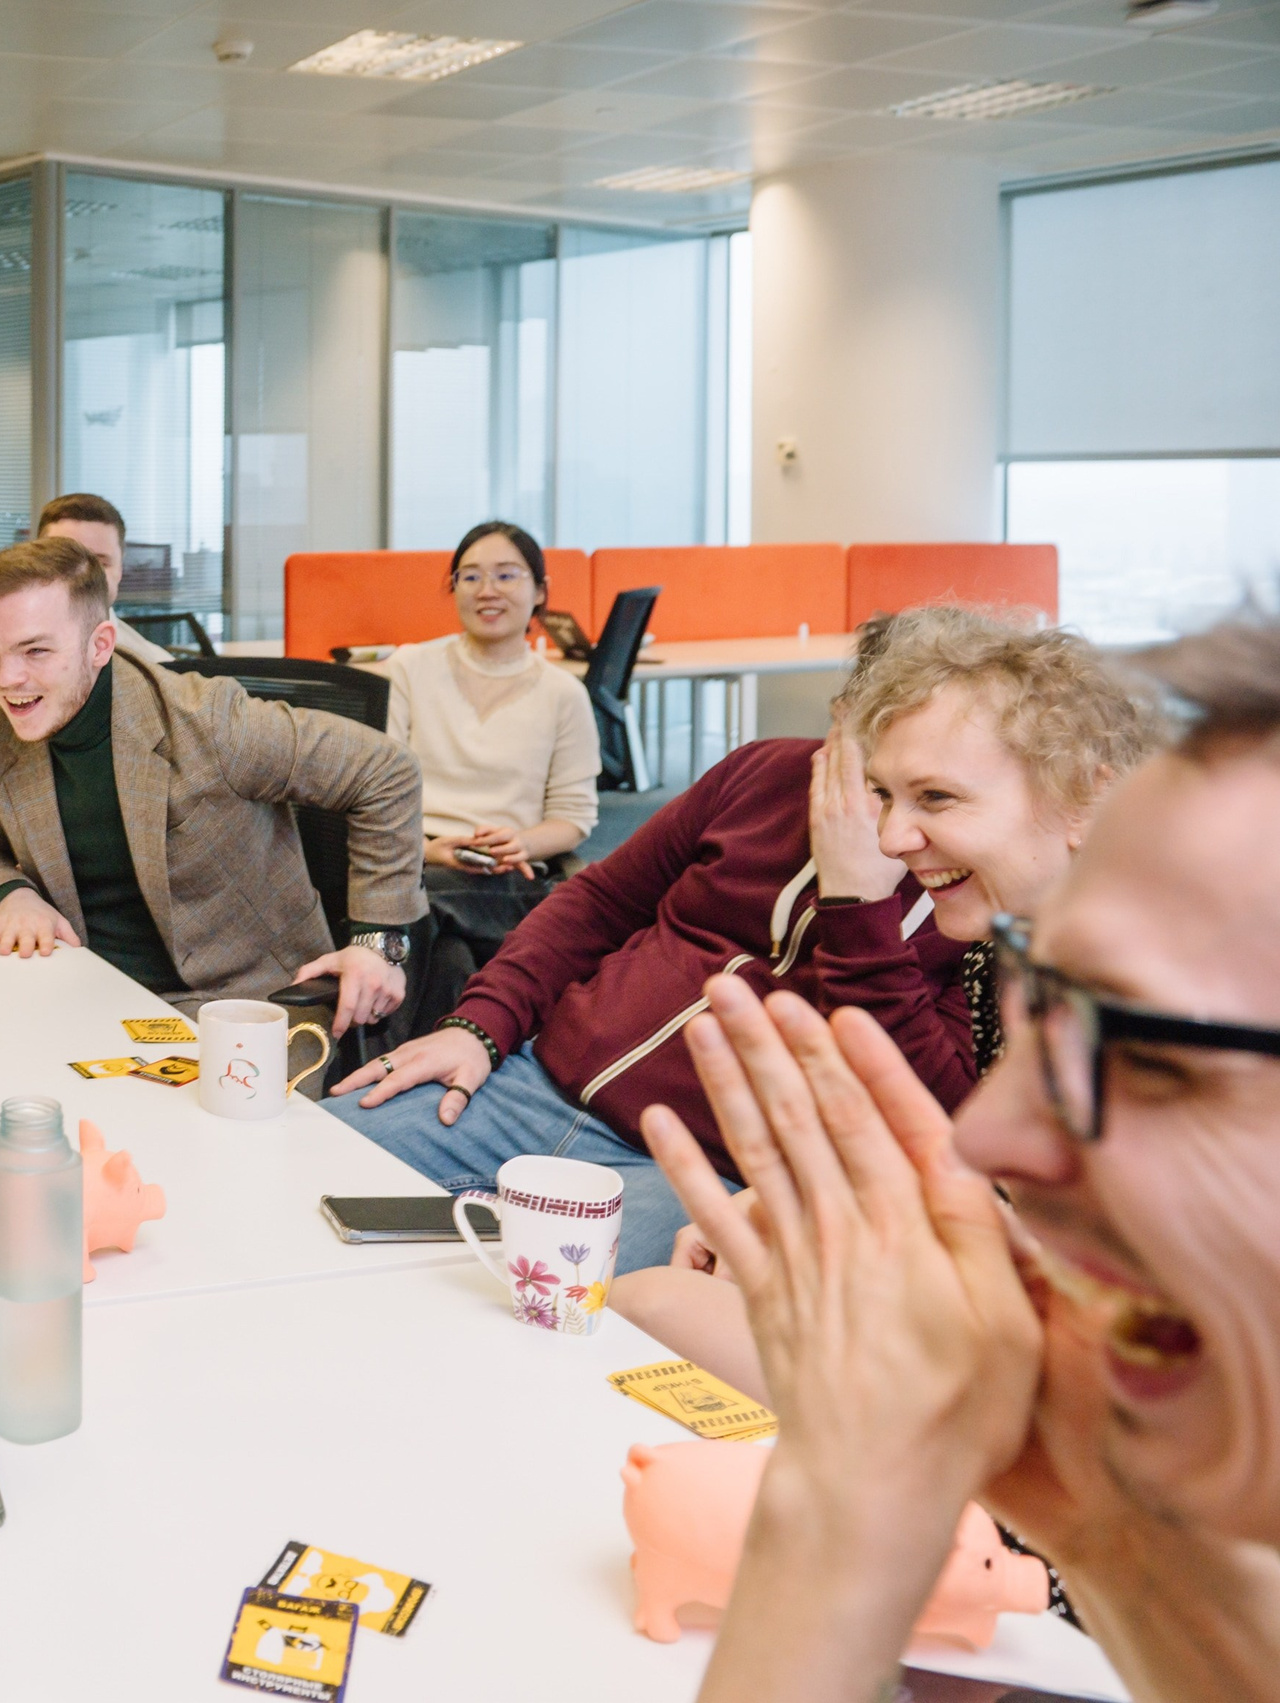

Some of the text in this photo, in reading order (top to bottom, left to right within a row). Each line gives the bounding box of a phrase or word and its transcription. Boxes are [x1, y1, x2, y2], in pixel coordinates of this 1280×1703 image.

[277, 1599, 323, 1615] БАГАЖ
[231, 1670, 332, 1702] ИНСТРУМЕНТЫ
[242, 1666, 324, 1692] СТОЛЯРНЫЕ
